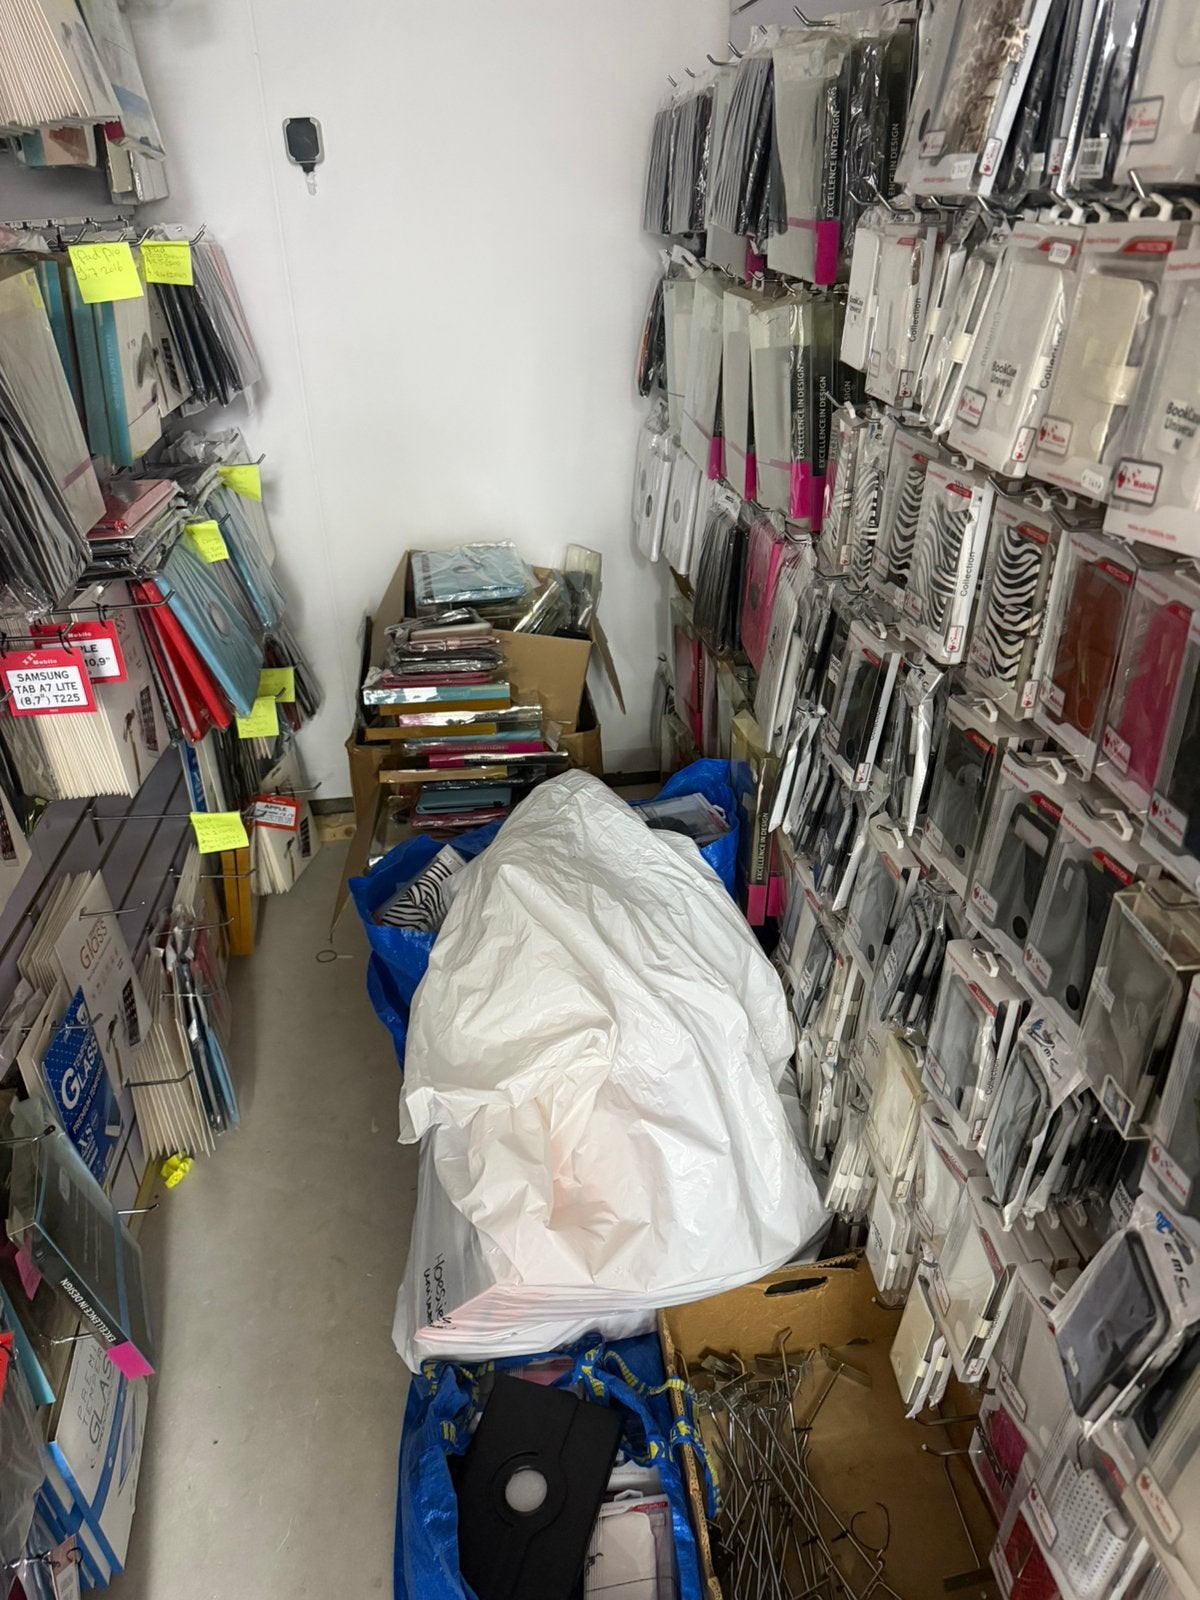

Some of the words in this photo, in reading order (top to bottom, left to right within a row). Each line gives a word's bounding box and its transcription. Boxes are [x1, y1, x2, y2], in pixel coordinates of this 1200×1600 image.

[832, 110, 840, 147] DESIGN
[890, 123, 899, 159] DESIGN
[830, 147, 838, 158] IN
[827, 160, 838, 218] EXCELLENCE
[909, 297, 921, 342] Collection
[797, 365, 805, 397] DESIGN
[844, 380, 852, 400] SIGN
[797, 398, 805, 408] IN
[797, 408, 805, 459] EXCELLENCE
[818, 418, 827, 468] EXCELLENCE
[960, 551, 976, 597] Collection
[80, 643, 99, 654] PLE
[15, 684, 36, 695] TAB
[40, 683, 52, 693] A7
[56, 681, 78, 692] LITE
[16, 670, 70, 683] SAMSUNG
[53, 693, 81, 704] T225
[264, 803, 288, 812] APPLE
[761, 812, 769, 836] DESIGN
[757, 844, 766, 881] EXCELLENCE
[80, 922, 108, 969] Glass
[62, 1036, 99, 1110] GLASS
[59, 1277, 83, 1303] DESIGN
[84, 1307, 117, 1343] EXCELLENCE
[88, 1353, 114, 1445] GLAS
